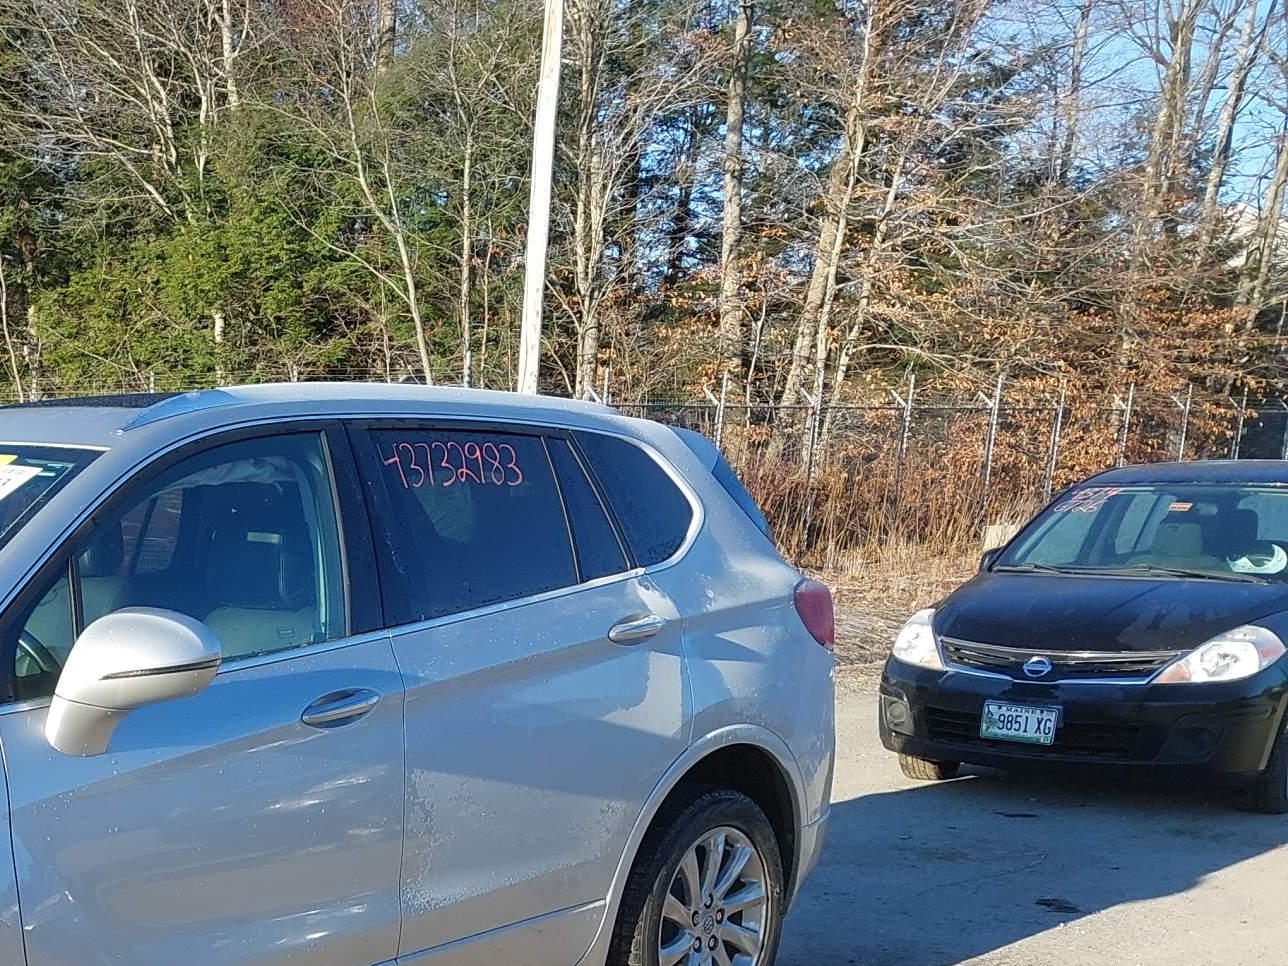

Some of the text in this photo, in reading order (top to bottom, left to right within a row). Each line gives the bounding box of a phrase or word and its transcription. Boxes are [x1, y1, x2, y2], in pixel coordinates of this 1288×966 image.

[376, 441, 523, 489] 43732983
[997, 713, 1053, 736] 9851 XG
